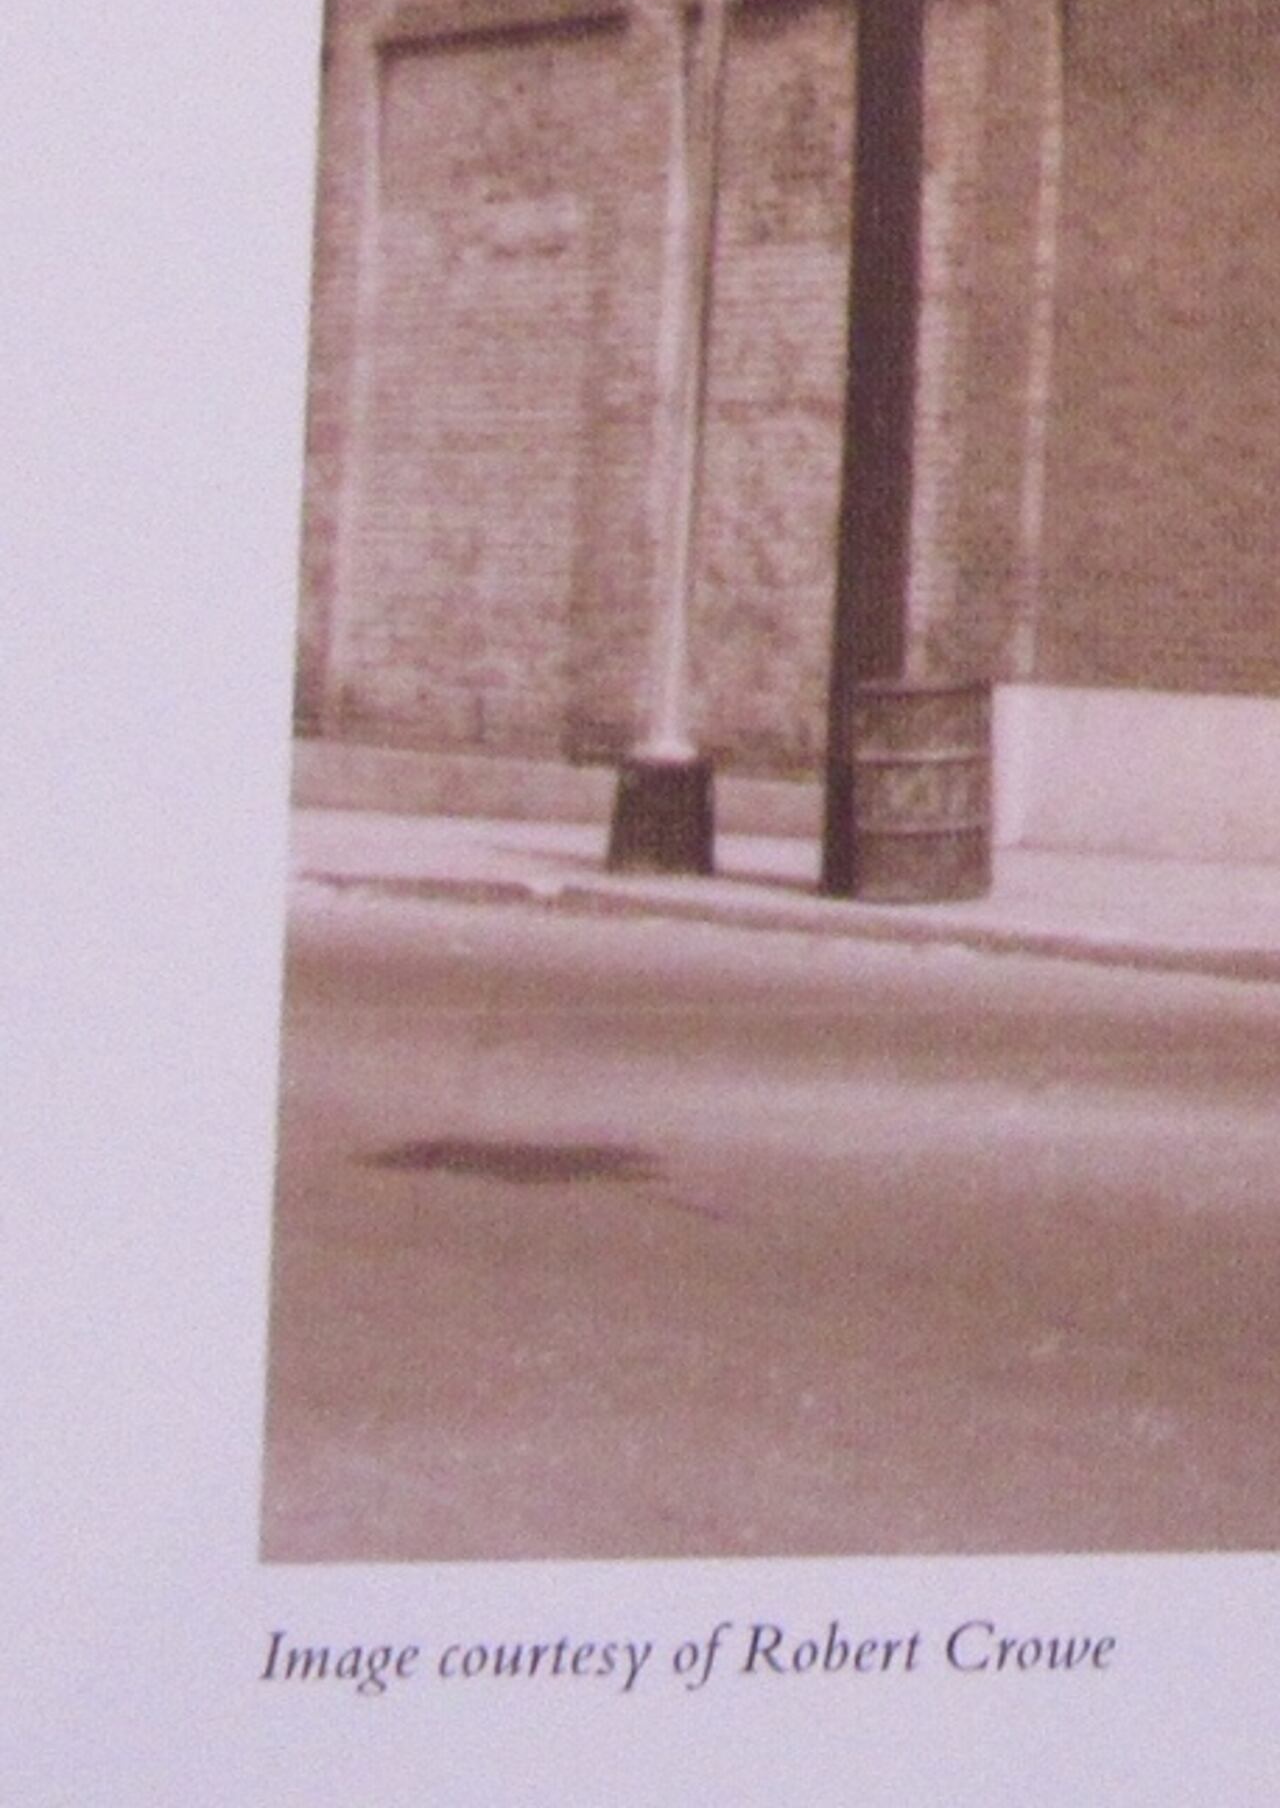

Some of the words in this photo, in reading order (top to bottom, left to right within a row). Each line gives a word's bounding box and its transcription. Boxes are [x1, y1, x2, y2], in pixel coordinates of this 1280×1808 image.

[259, 1629, 419, 1696] Image
[437, 1632, 650, 1691] courtesy
[672, 1621, 731, 1690] of
[740, 1621, 922, 1674] Robert
[945, 1619, 1117, 1674] Crowe
